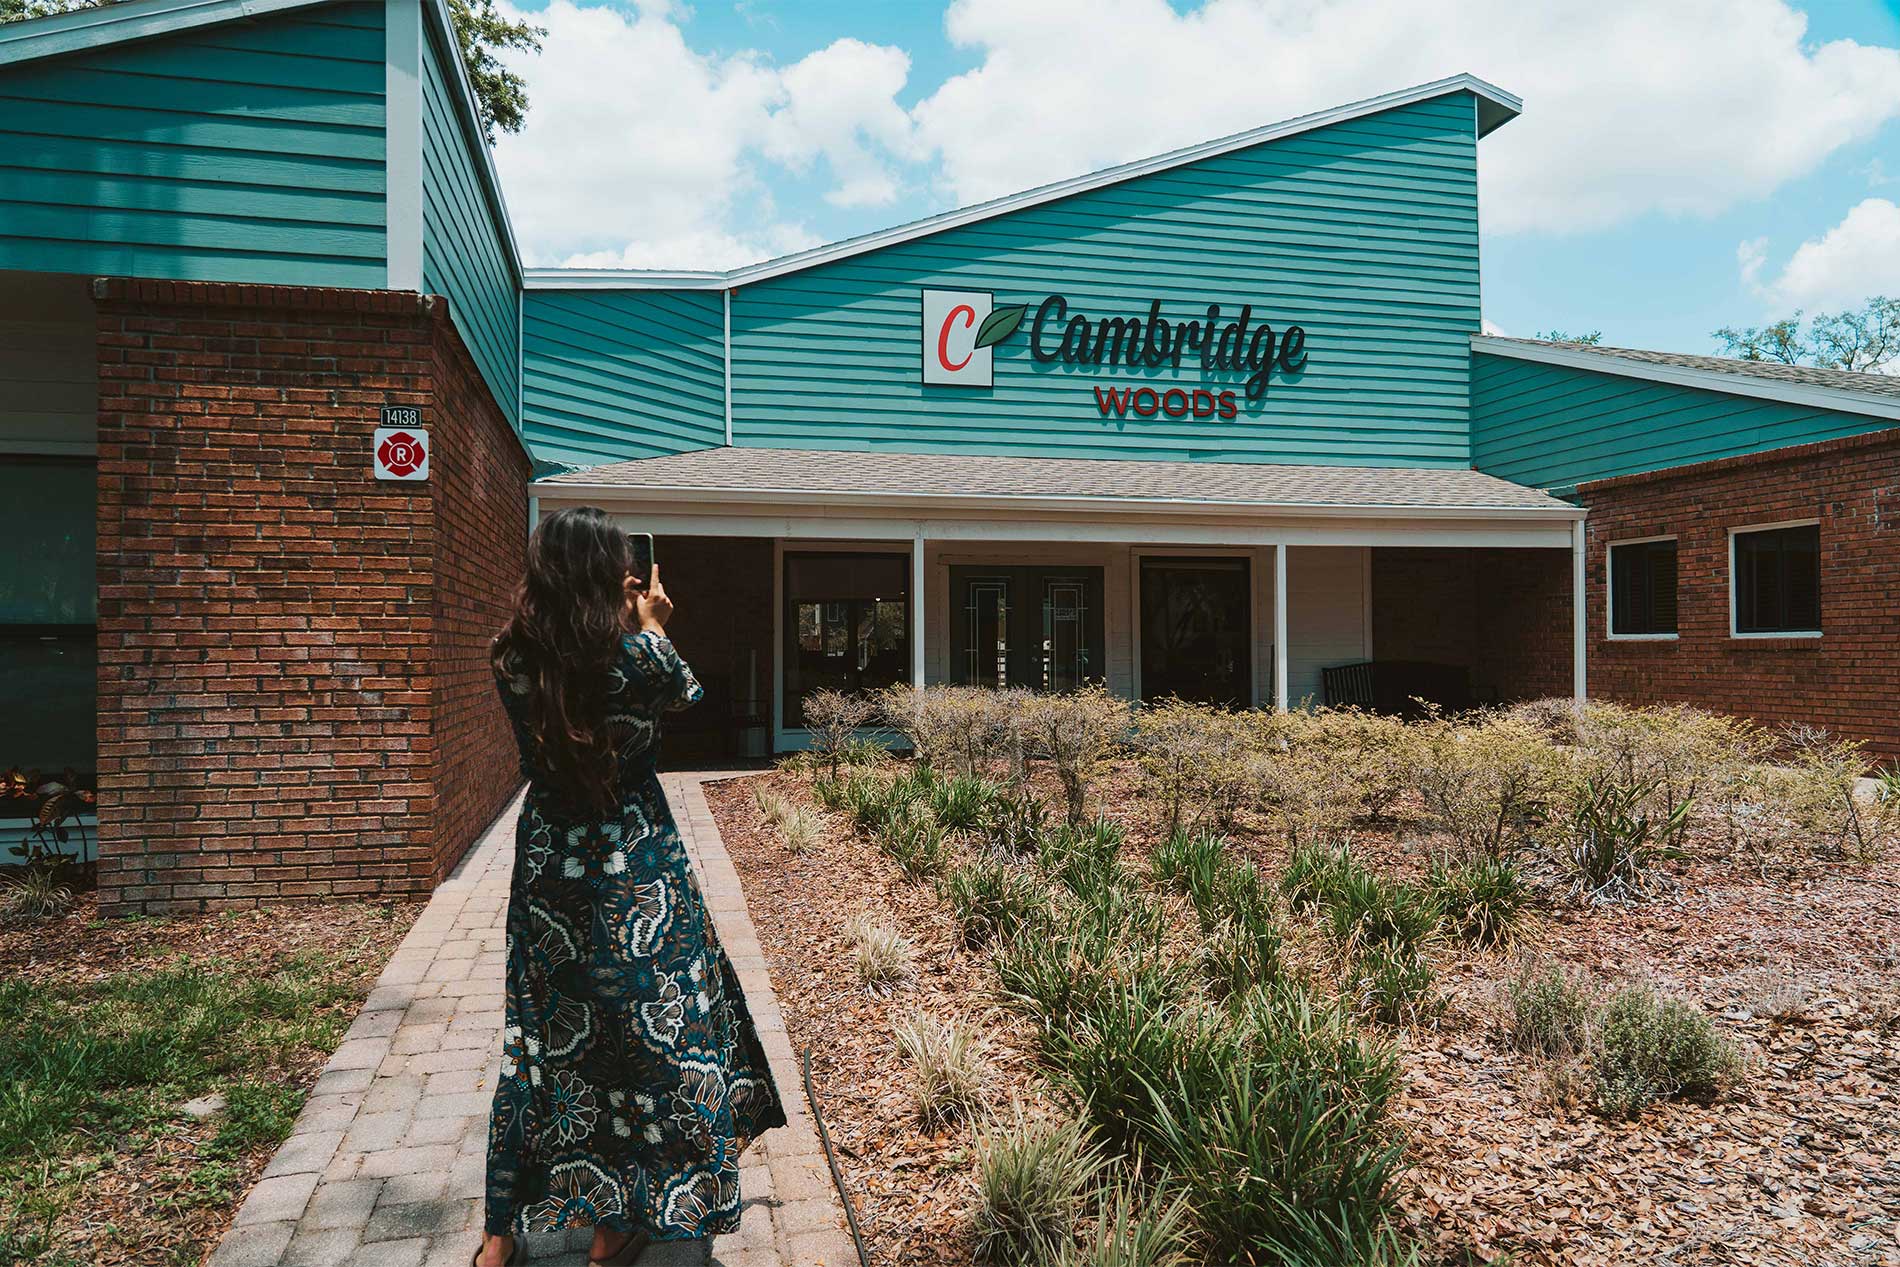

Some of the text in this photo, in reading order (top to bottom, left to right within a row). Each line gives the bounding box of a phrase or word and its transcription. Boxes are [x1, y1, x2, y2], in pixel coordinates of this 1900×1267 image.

[937, 304, 976, 372] C
[1031, 295, 1308, 401] Cambridge
[386, 409, 417, 425] 14138
[1093, 386, 1238, 420] WOODS
[396, 447, 407, 462] R
